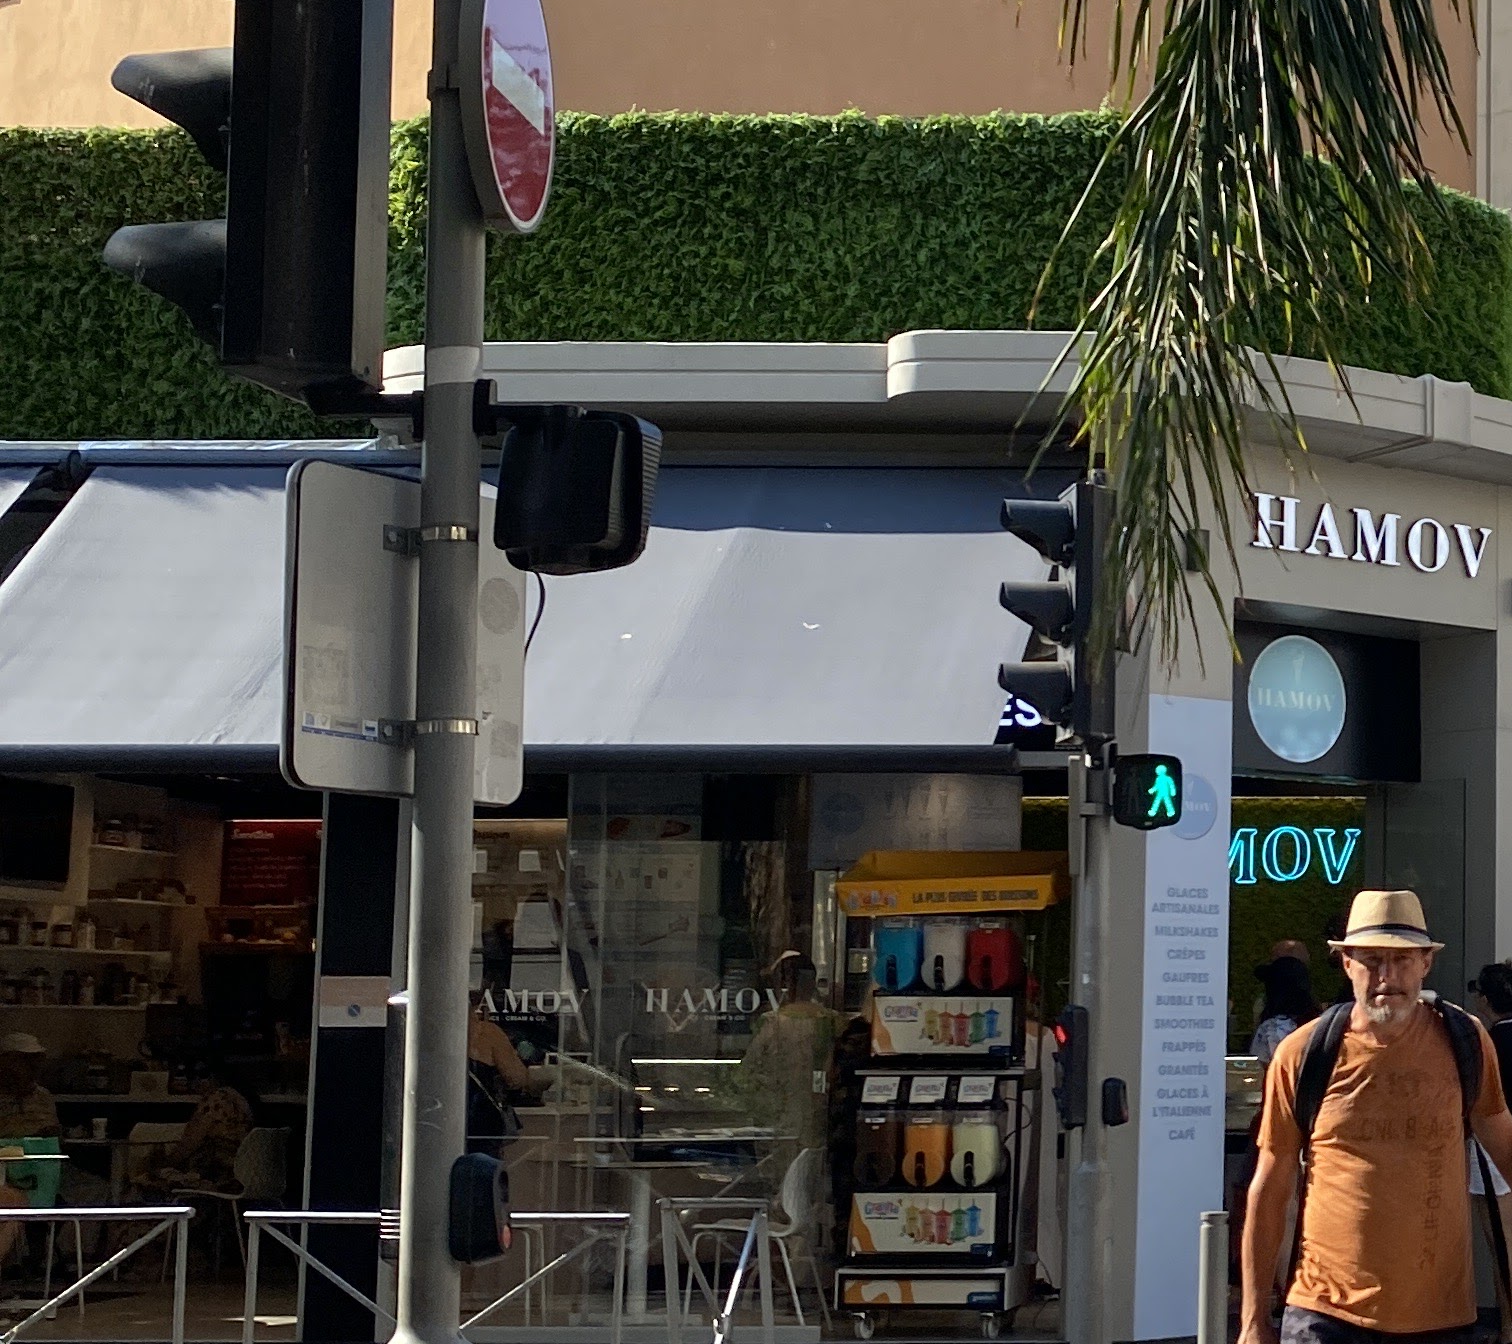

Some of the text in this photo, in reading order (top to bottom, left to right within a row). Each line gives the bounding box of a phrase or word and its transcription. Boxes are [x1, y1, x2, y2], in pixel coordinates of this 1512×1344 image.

[1250, 492, 1493, 579] HAMOV
[1257, 687, 1336, 712] HAMOV
[1228, 826, 1361, 884] MOV
[1167, 887, 1209, 899] GLACES
[1152, 902, 1220, 915] ARTISANALES
[1154, 925, 1219, 937] MILKSHAKES
[1167, 946, 1206, 960] CRÊPES
[1162, 972, 1210, 983] GAUFRES
[475, 988, 589, 1014] AMOV
[646, 987, 788, 1013] HAMOV
[1156, 995, 1215, 1006] BUBBLE TEA
[1154, 1018, 1216, 1030] SMOOTHIES
[1162, 1039, 1207, 1052] FRAPPÉS
[1158, 1062, 1209, 1076] GRANITÉS
[1157, 1088, 1198, 1099] GLACES
[1152, 1105, 1212, 1117] L'ITALIENNE
[1168, 1126, 1196, 1140] CAFÉ
